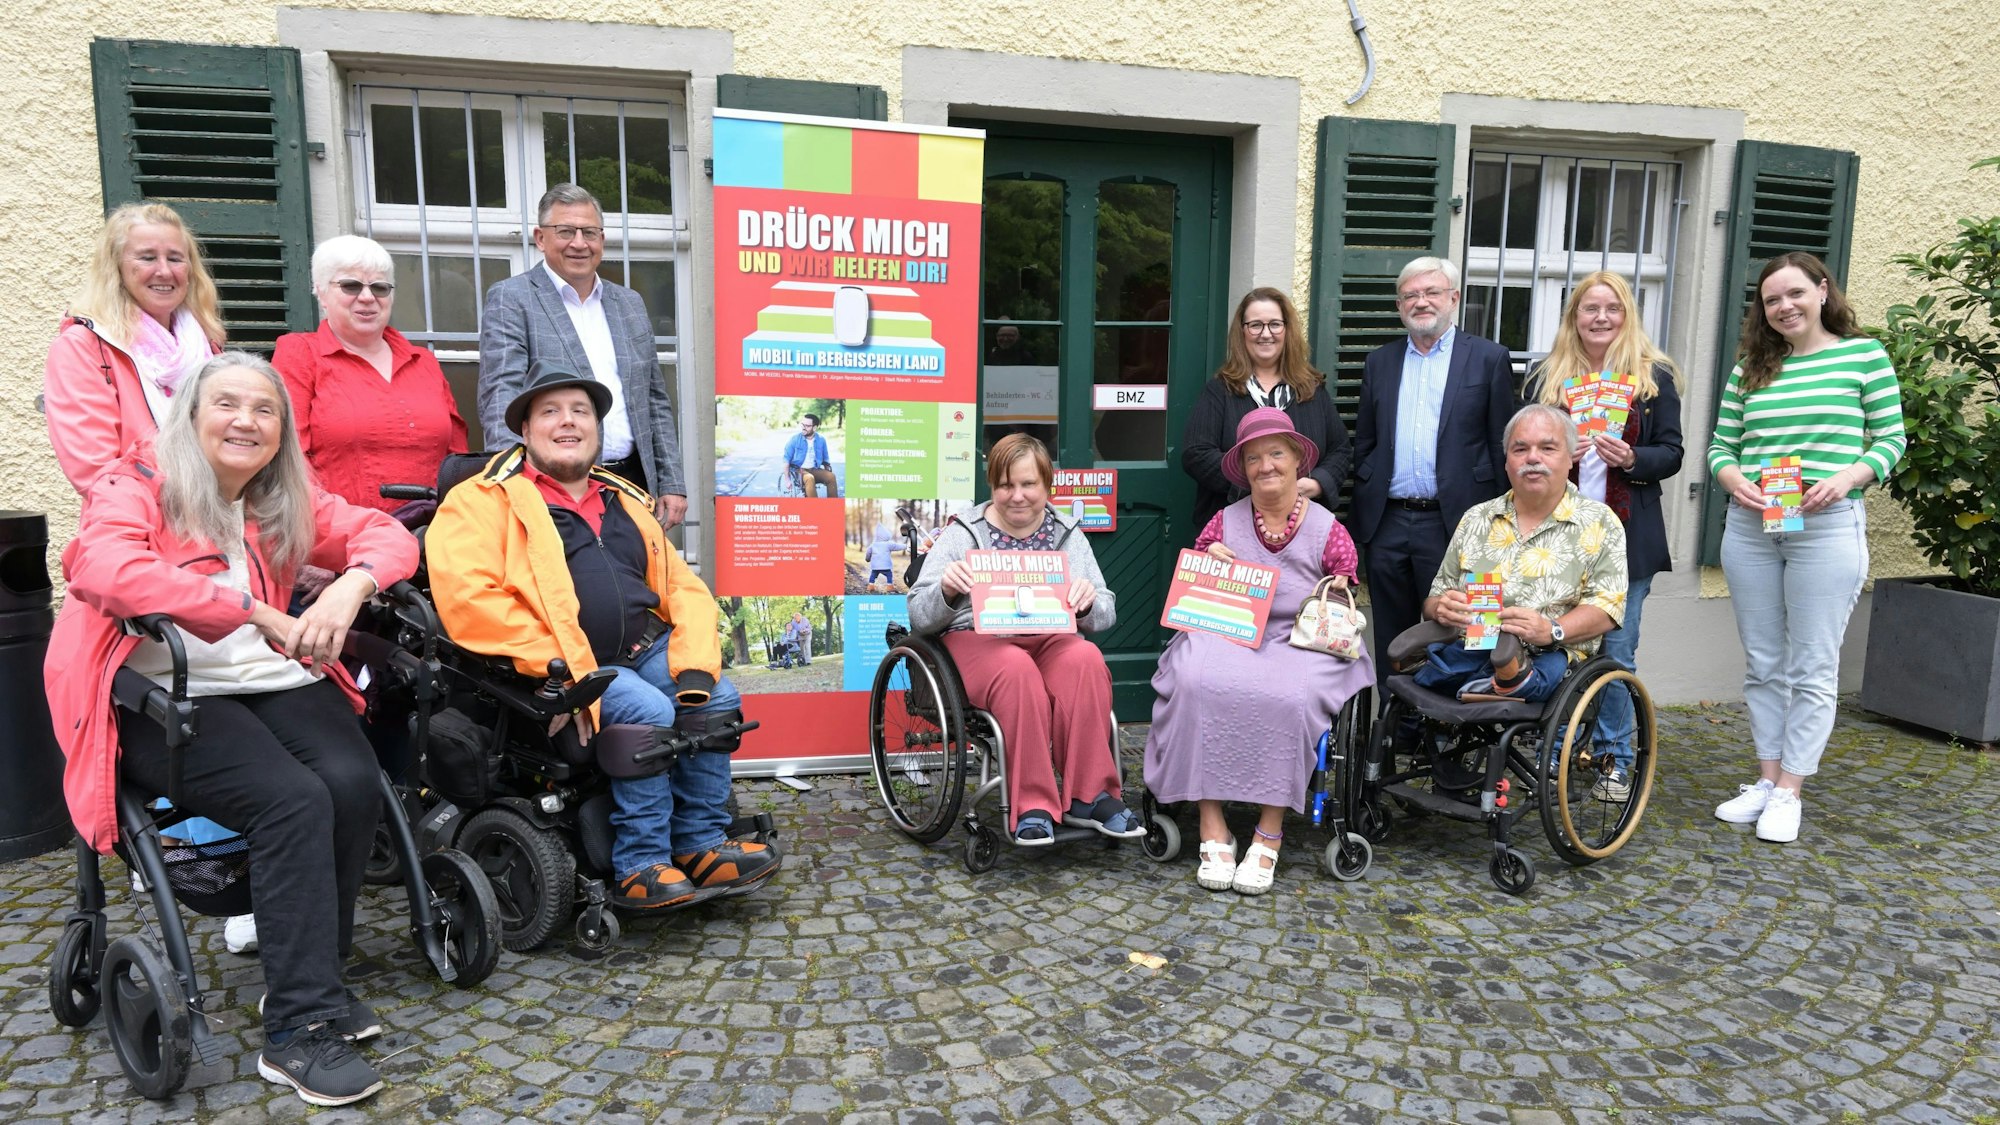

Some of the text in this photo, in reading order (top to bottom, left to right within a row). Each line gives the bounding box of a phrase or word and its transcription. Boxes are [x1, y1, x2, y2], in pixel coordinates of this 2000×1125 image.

[738, 206, 949, 258] DRÜCK MICH
[738, 251, 948, 283] UND WIR HELFEN DIR!
[749, 348, 939, 371] MOBIL im BERGISCHEN LAND
[1116, 391, 1145, 403] BMZ
[860, 407, 904, 416] PROJEKTIDEE:
[1052, 470, 1113, 486] RÜCK MICH
[1073, 486, 1097, 495] HELFEN
[1098, 486, 1113, 495] DIR!
[750, 504, 778, 513] PROJEKT
[734, 515, 780, 523] VORSTELLUNG
[970, 552, 1064, 572] DRÜCK MICH
[973, 573, 992, 584] UND
[1014, 573, 1044, 584] HELFEN
[1046, 573, 1064, 584] DIR!
[1180, 553, 1274, 588] DRÜCK MICH
[1178, 570, 1268, 599] UND WIR HELFEN DIR!
